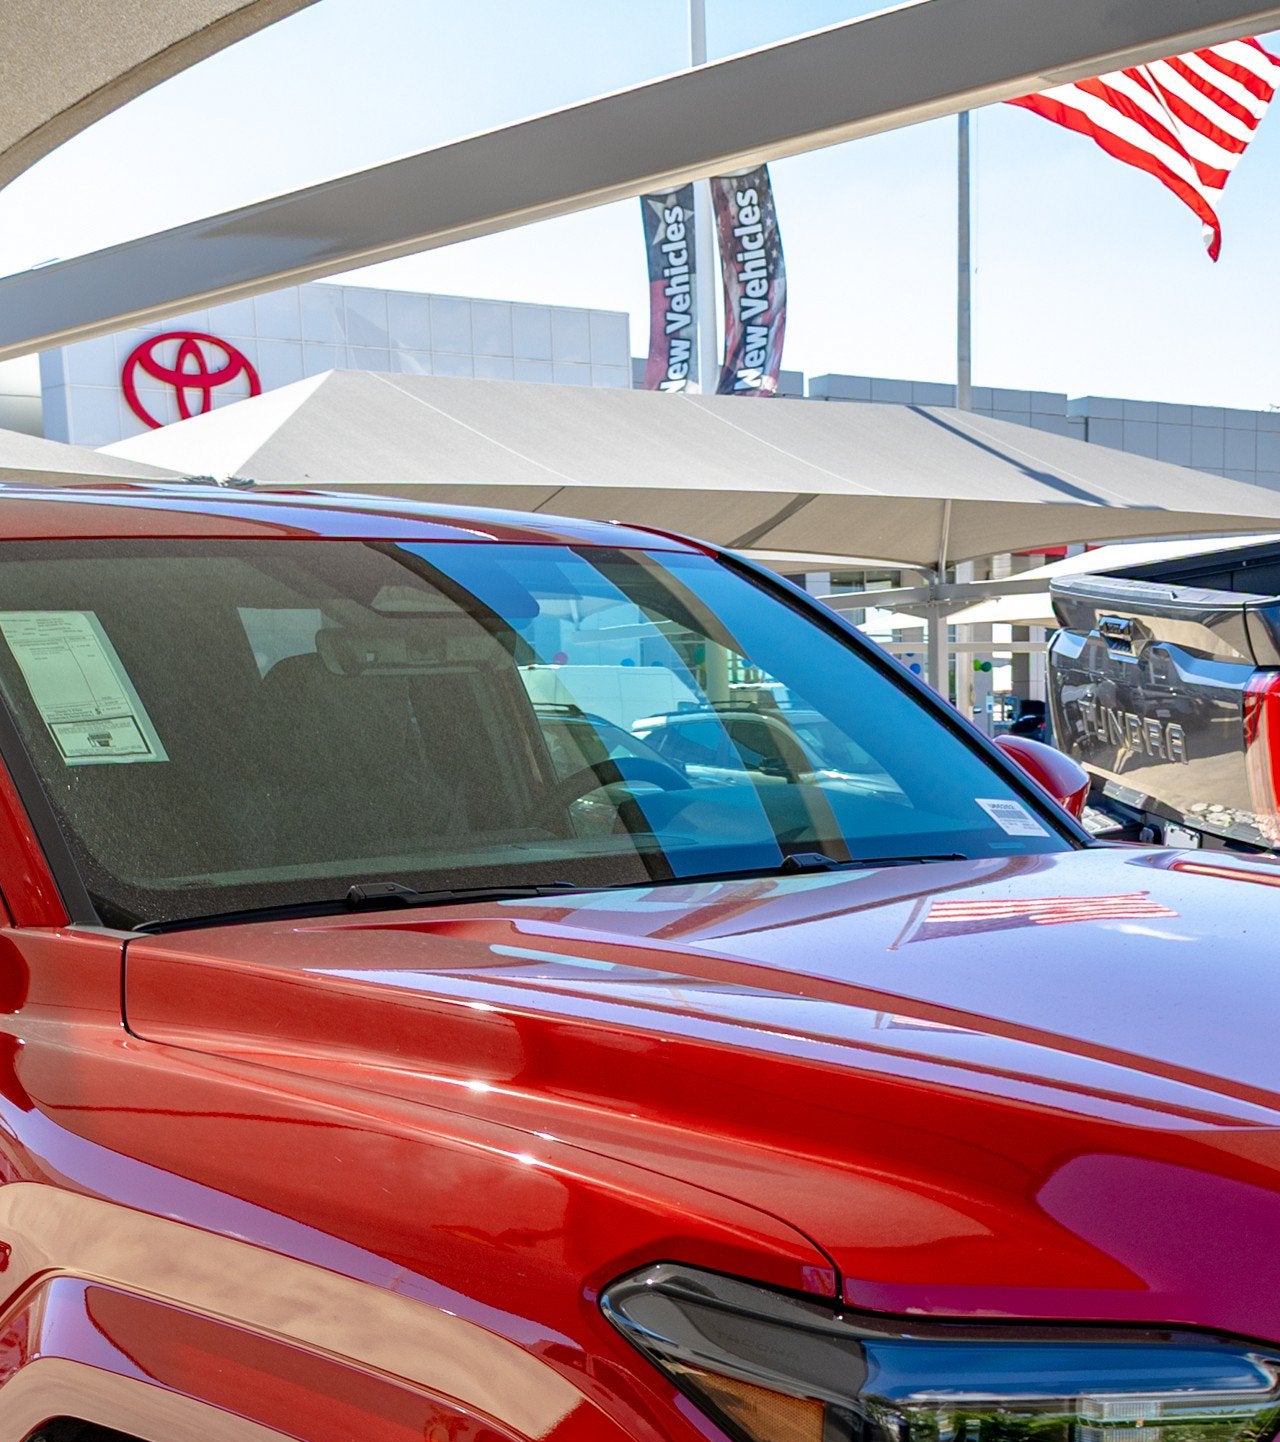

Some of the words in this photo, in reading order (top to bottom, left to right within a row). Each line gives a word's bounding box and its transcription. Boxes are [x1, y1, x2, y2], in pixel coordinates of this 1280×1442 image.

[662, 205, 692, 334] Vehicles
[734, 187, 770, 321] Vehicles
[733, 325, 769, 391] New
[1077, 699, 1188, 765] TUNDRA
